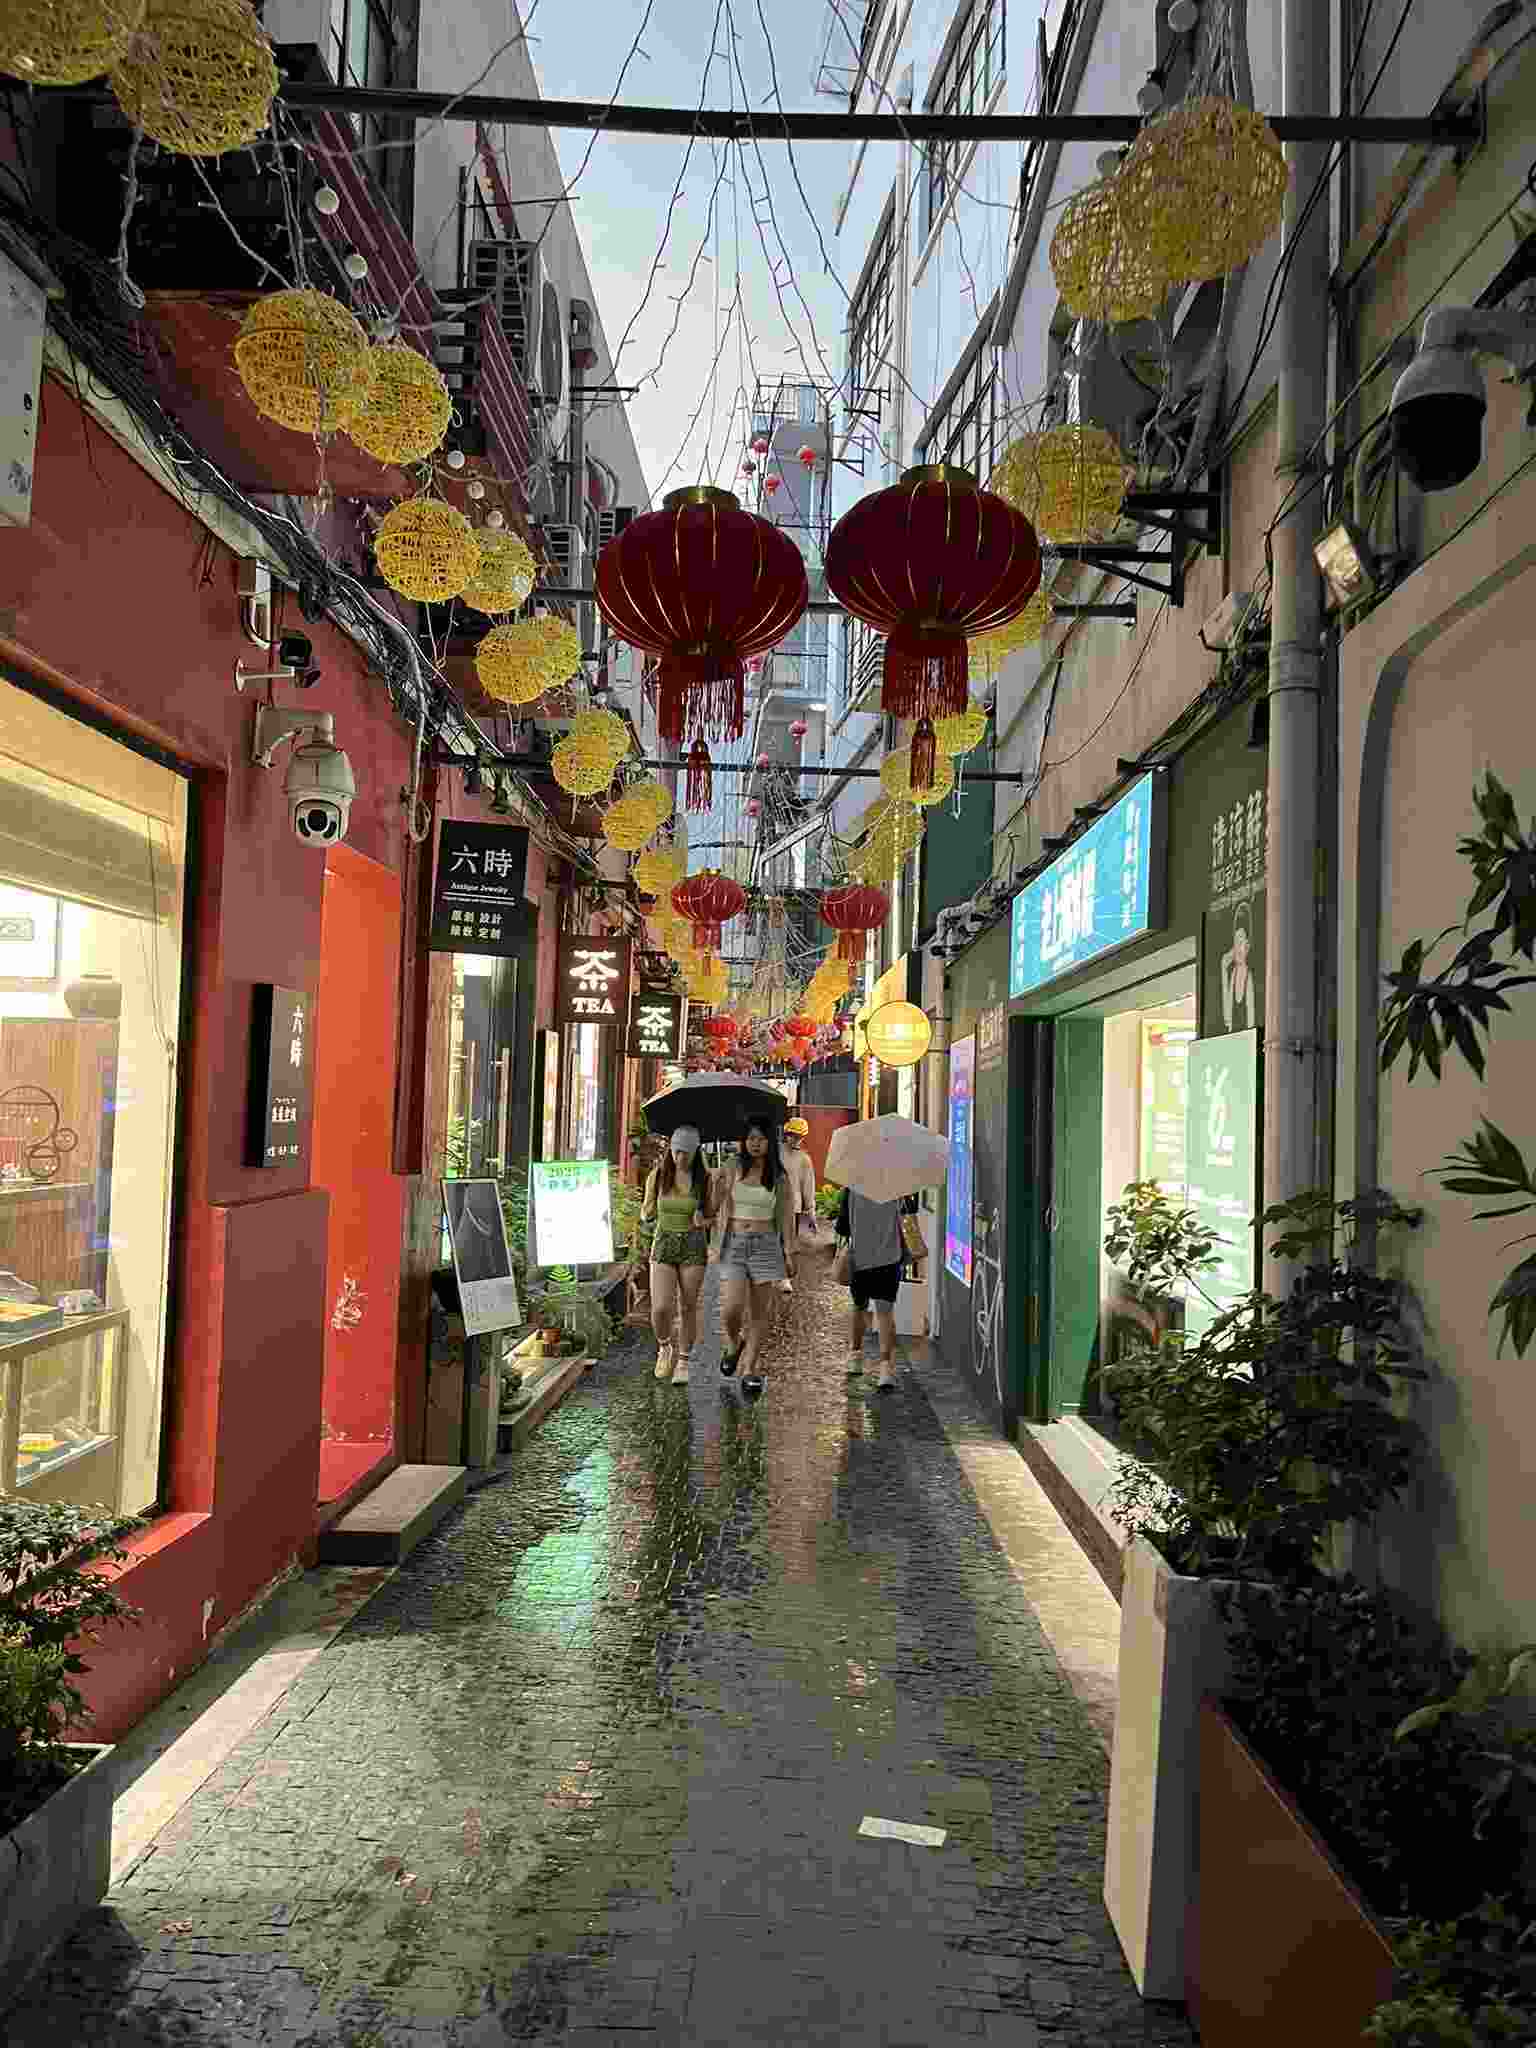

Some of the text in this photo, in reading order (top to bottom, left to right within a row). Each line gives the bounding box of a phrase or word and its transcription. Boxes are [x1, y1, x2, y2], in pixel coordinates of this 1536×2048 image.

[449, 844, 513, 877] 六時
[571, 997, 616, 1015] TEA
[638, 1039, 671, 1053] TEA
